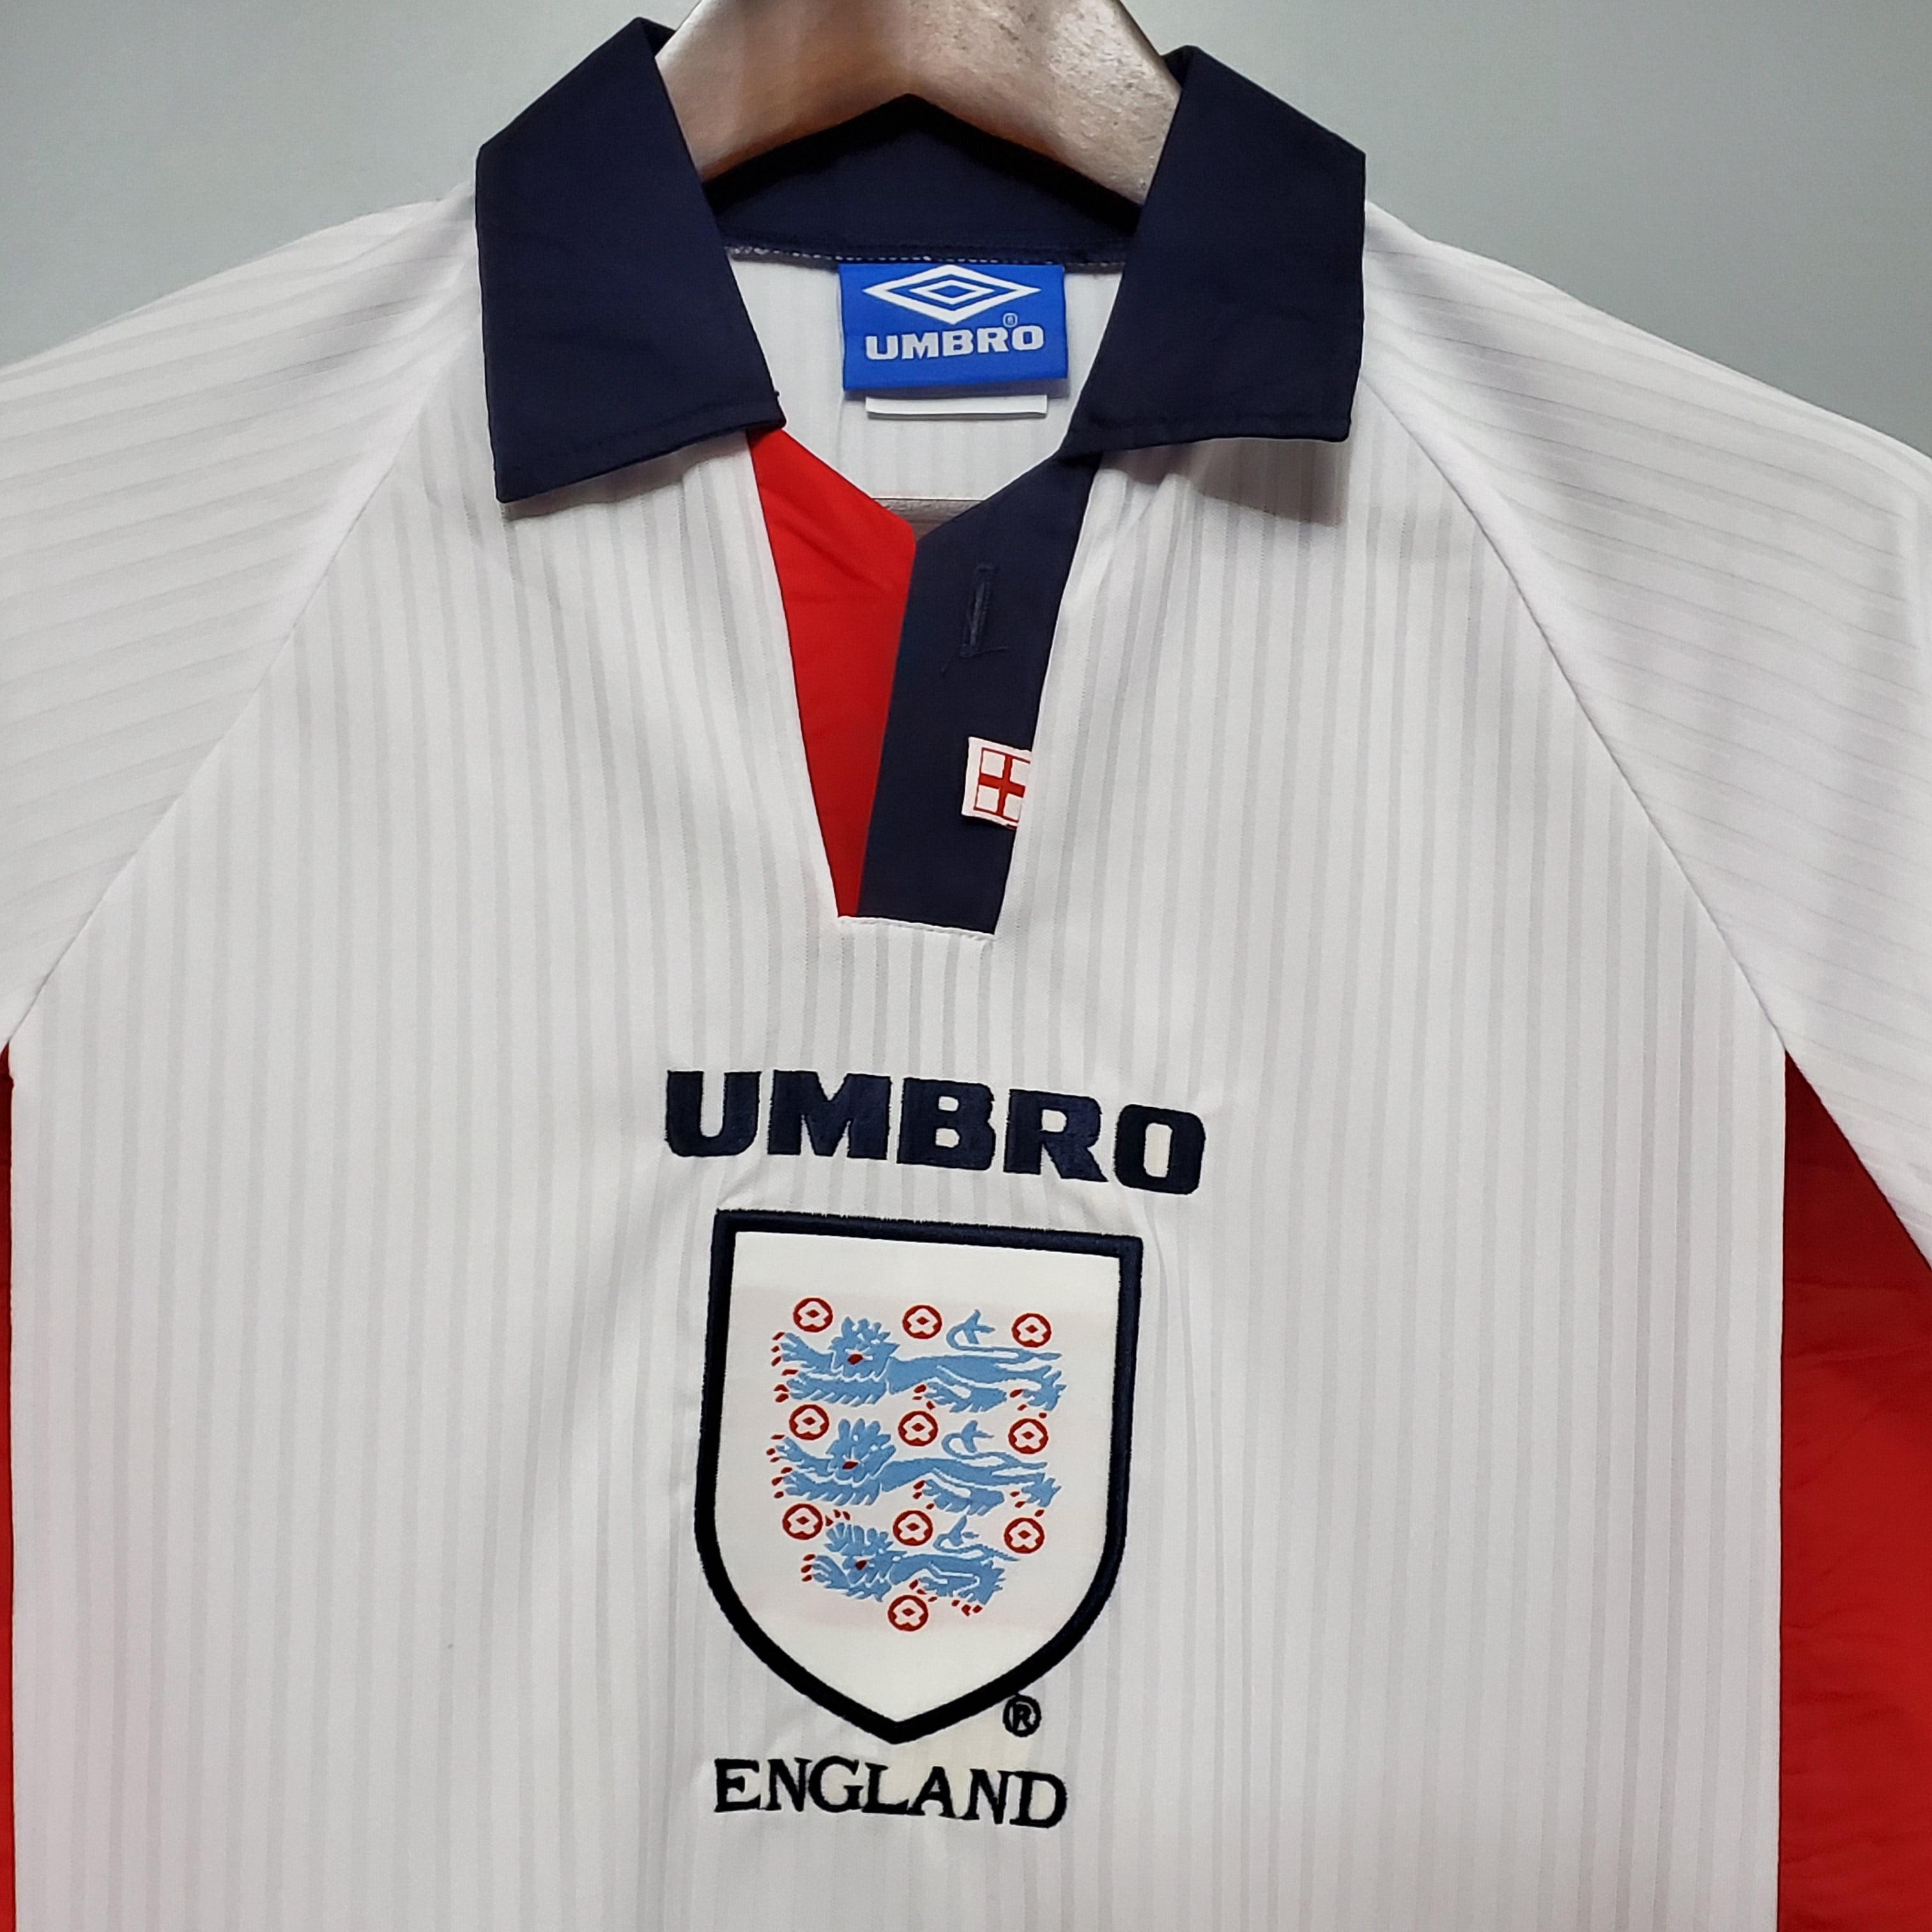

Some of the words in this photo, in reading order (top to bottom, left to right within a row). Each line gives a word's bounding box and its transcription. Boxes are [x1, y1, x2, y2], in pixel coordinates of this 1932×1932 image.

[865, 325, 1044, 360] UMBRO
[666, 1070, 1206, 1195] UMBRO
[714, 1755, 1068, 1828] ENGLAND
